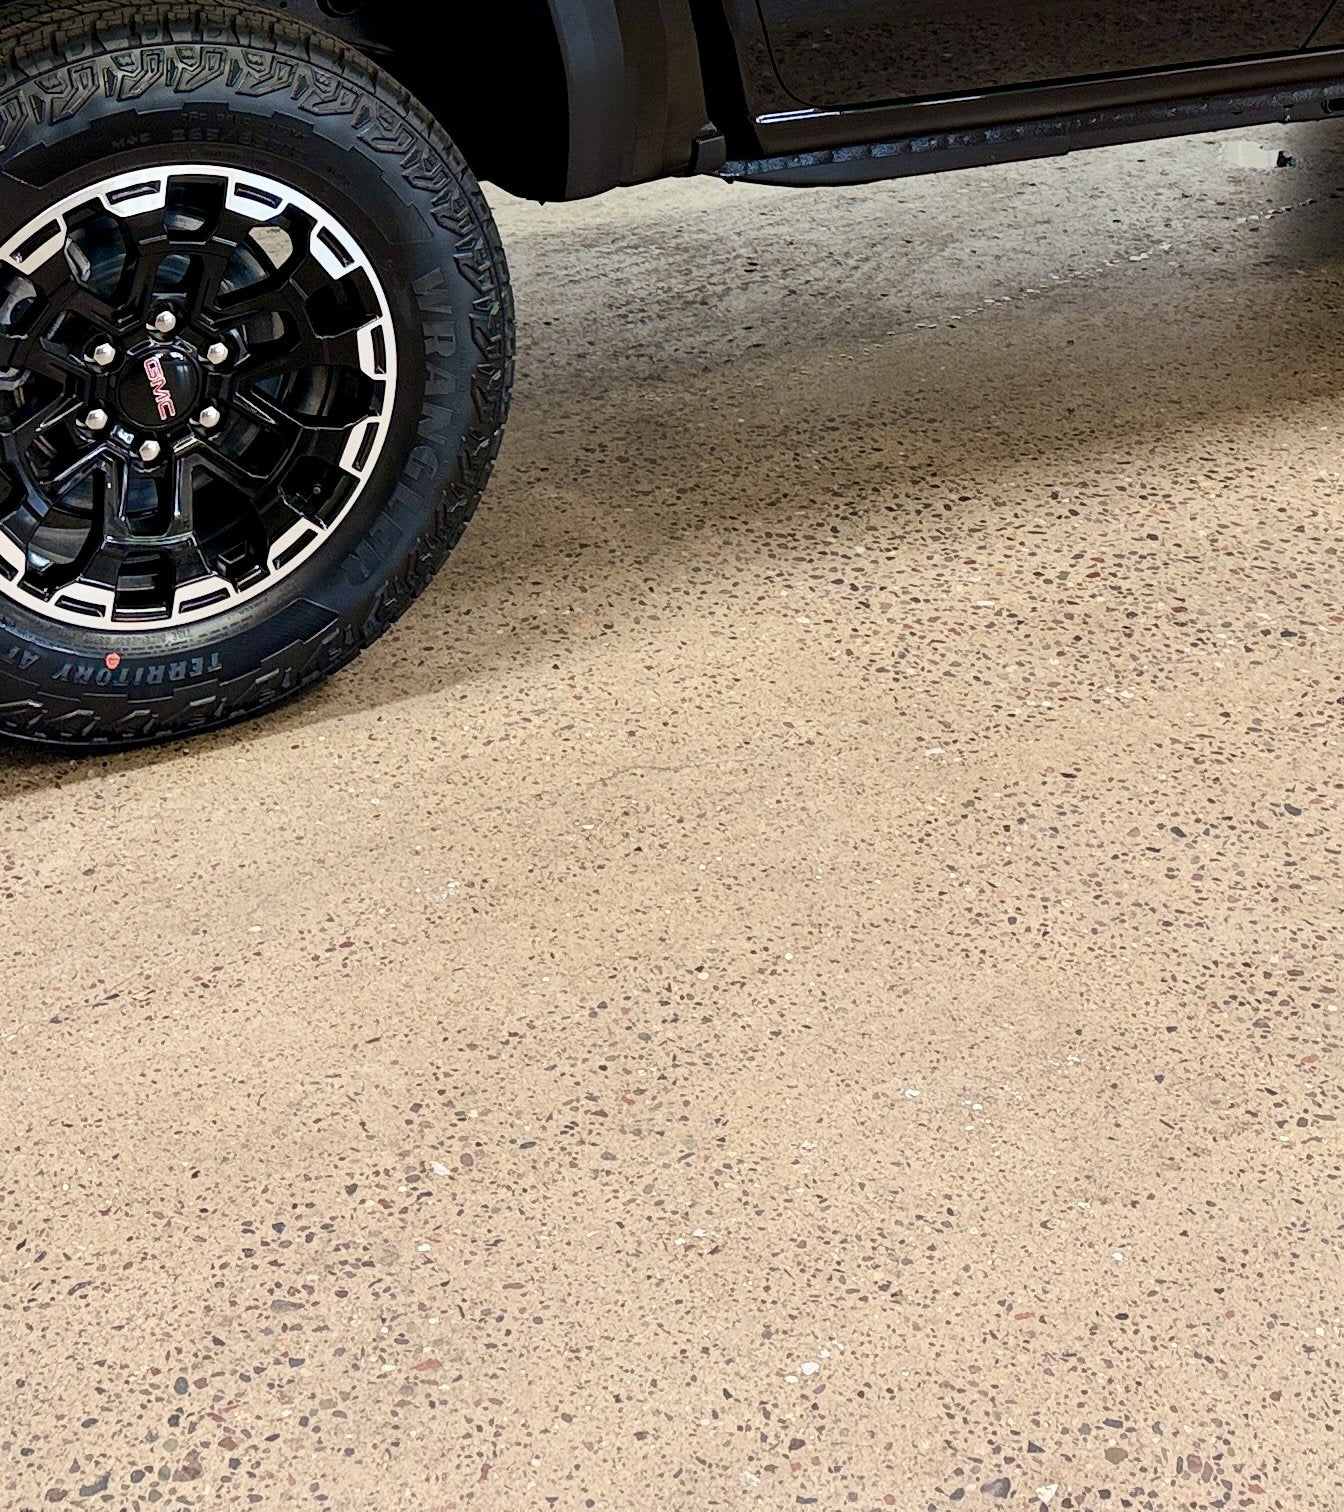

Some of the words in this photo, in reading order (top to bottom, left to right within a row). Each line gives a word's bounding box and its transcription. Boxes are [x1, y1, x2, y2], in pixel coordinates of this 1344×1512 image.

[143, 356, 177, 421] GMC
[341, 267, 457, 587] WRANGLER
[0, 646, 40, 671] AT
[52, 652, 223, 687] TERRITORY
